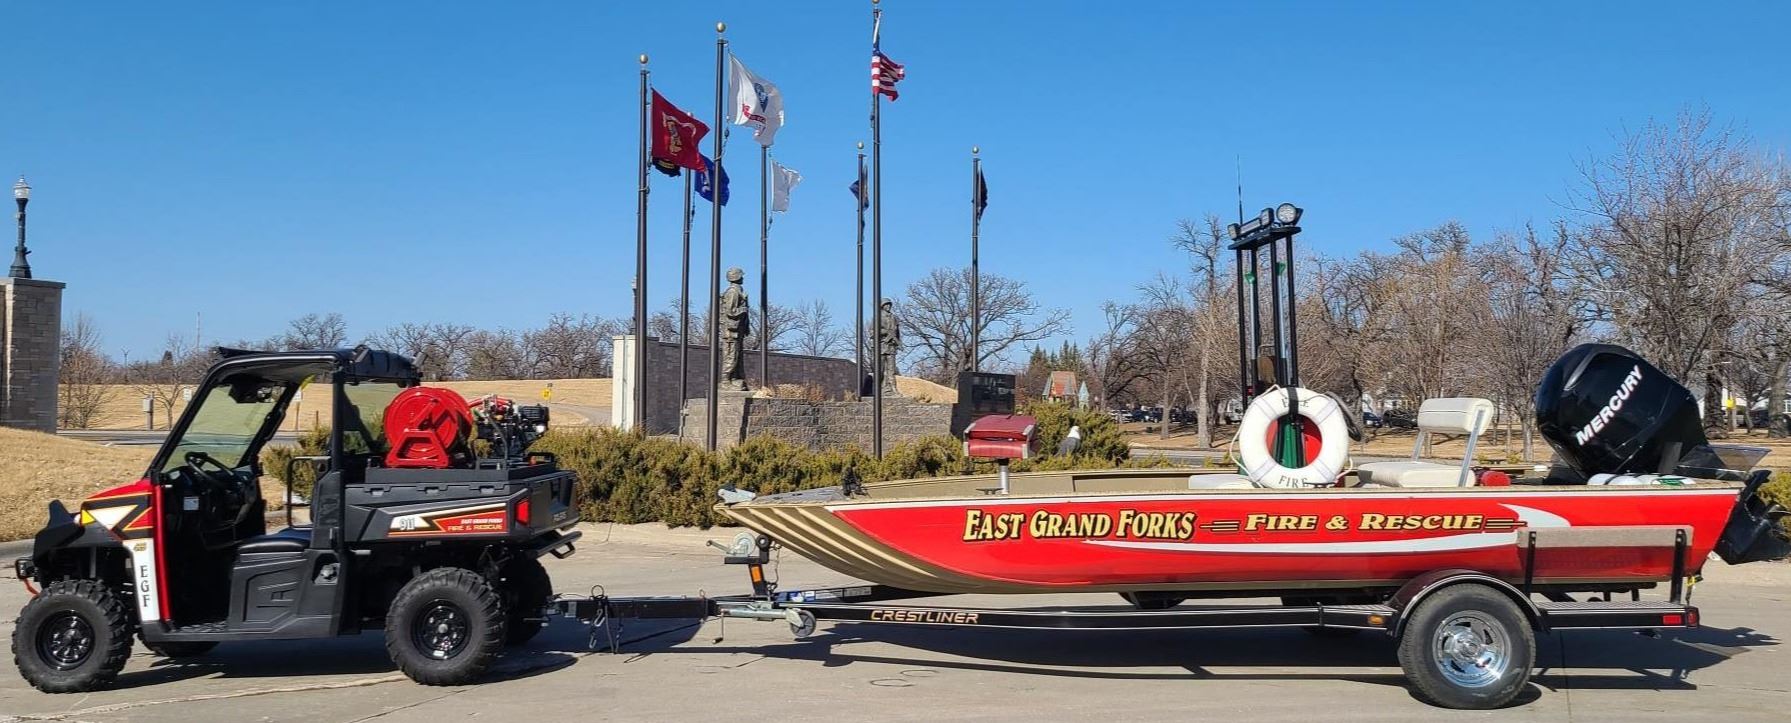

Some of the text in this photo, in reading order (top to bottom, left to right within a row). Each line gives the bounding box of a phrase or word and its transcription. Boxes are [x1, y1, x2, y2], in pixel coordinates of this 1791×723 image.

[1576, 364, 1642, 446] MERCURY
[1278, 475, 1309, 488] FIRE
[399, 517, 416, 531] 911
[963, 509, 1196, 542] EAST GRAND FORKS
[1244, 513, 1485, 531] FIRE & RESCUE
[871, 610, 979, 624] CRESTLINER
